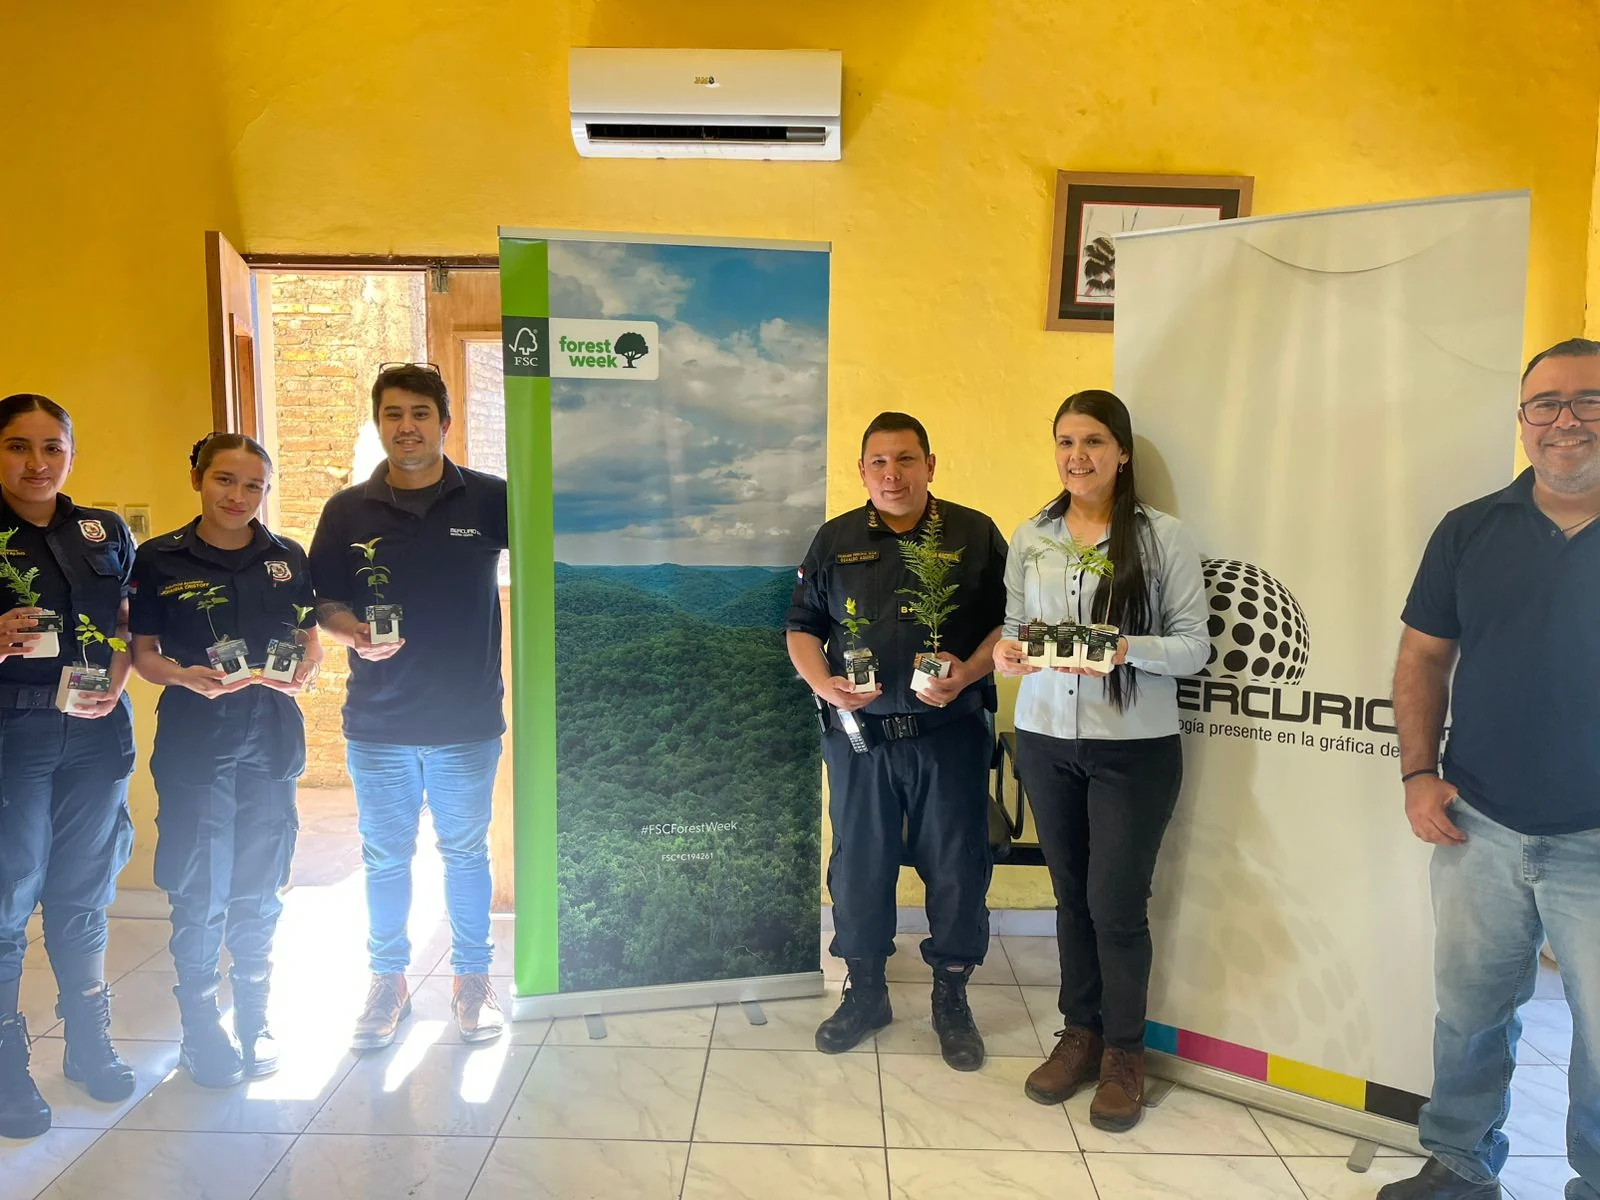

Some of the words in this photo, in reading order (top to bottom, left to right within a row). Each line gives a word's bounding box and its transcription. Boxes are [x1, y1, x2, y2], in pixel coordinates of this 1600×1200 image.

[559, 336, 611, 353] forest
[514, 356, 538, 367] FSC
[569, 355, 618, 368] week
[1176, 678, 1398, 734] ERCURIO
[1179, 718, 1205, 734] ogía
[1209, 723, 1272, 741] presente
[1277, 731, 1296, 744] en
[1301, 731, 1314, 747] la
[1319, 736, 1374, 755] gráfica
[641, 820, 738, 835] #FSCForestWeek
